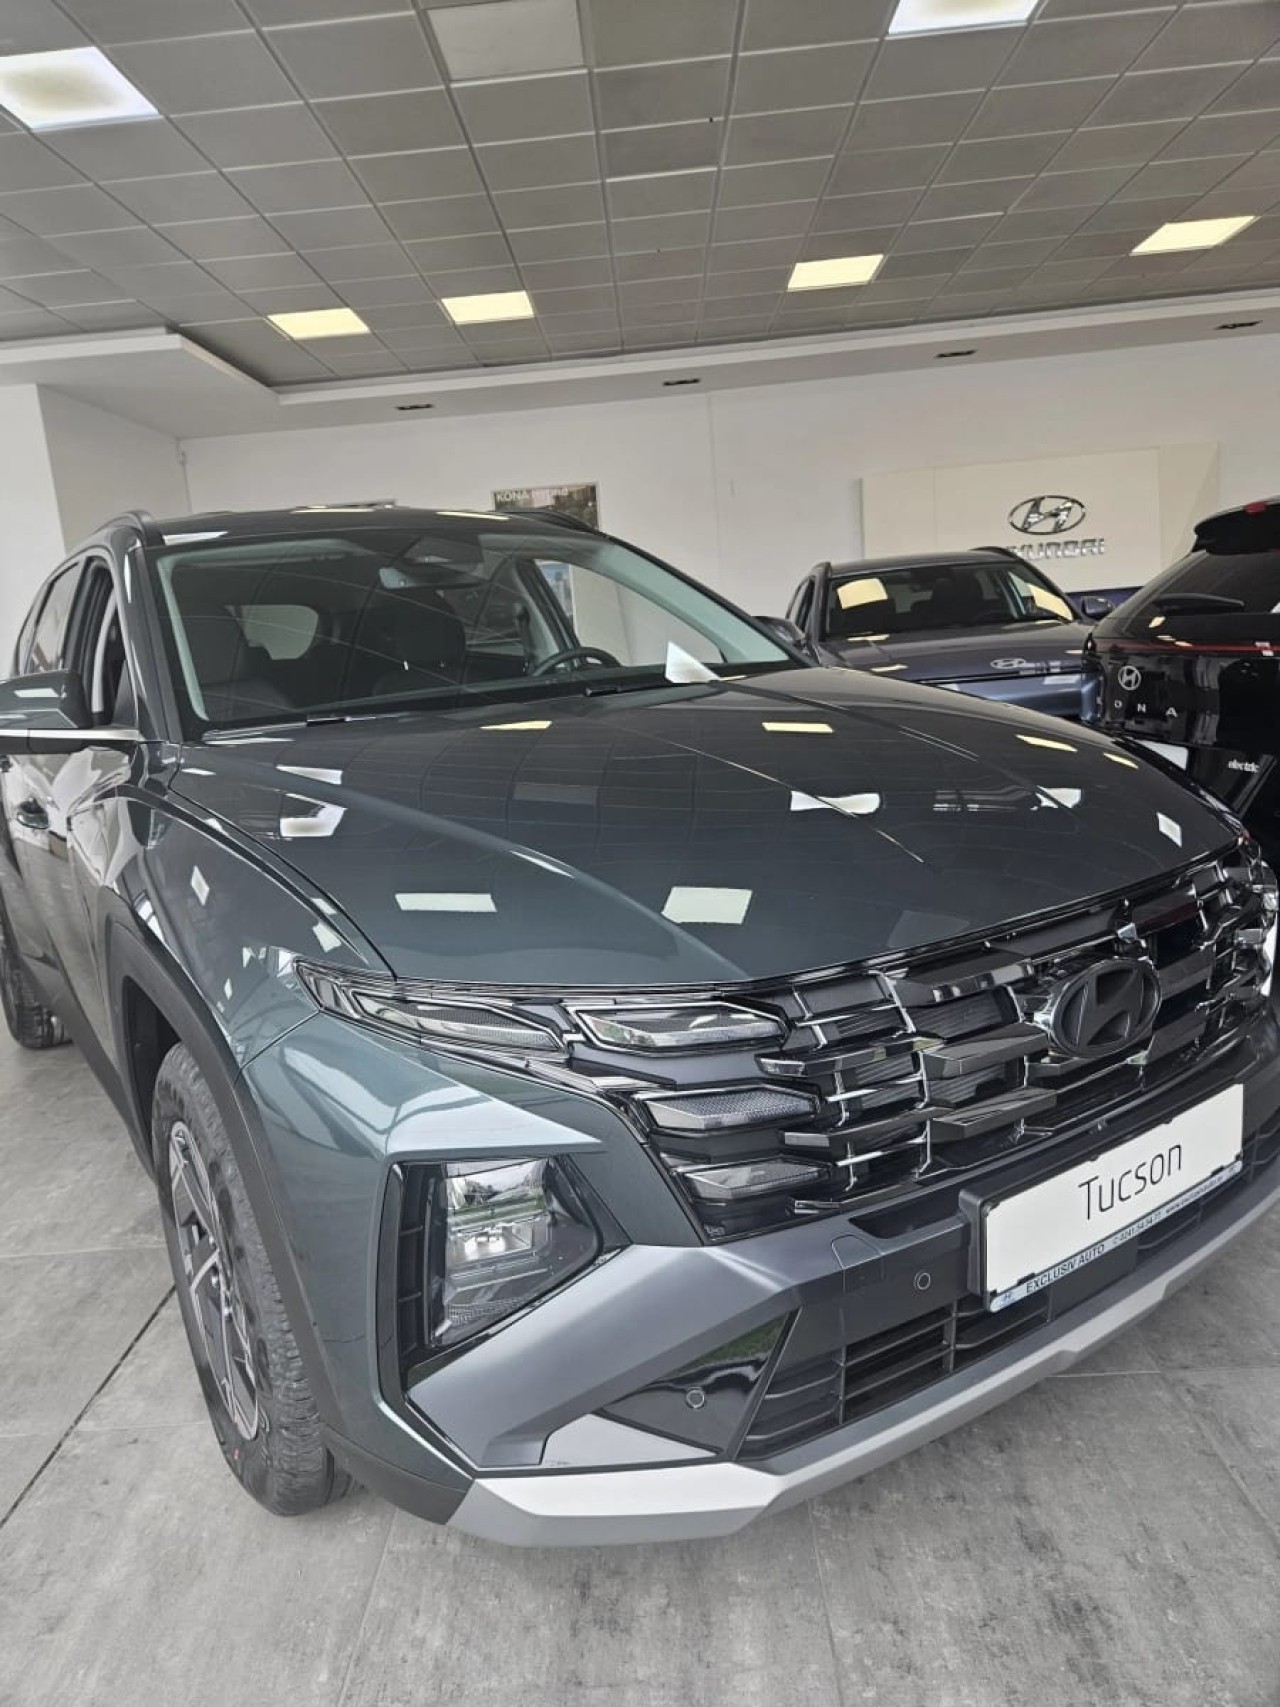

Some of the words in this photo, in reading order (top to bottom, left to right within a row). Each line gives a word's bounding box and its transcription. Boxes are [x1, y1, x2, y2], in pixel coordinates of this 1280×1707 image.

[497, 489, 529, 502] KONA
[1078, 1144, 1182, 1220] Tucson
[1026, 1259, 1077, 1294] EXCLUSIV
[1078, 1243, 1105, 1267] AUTO
